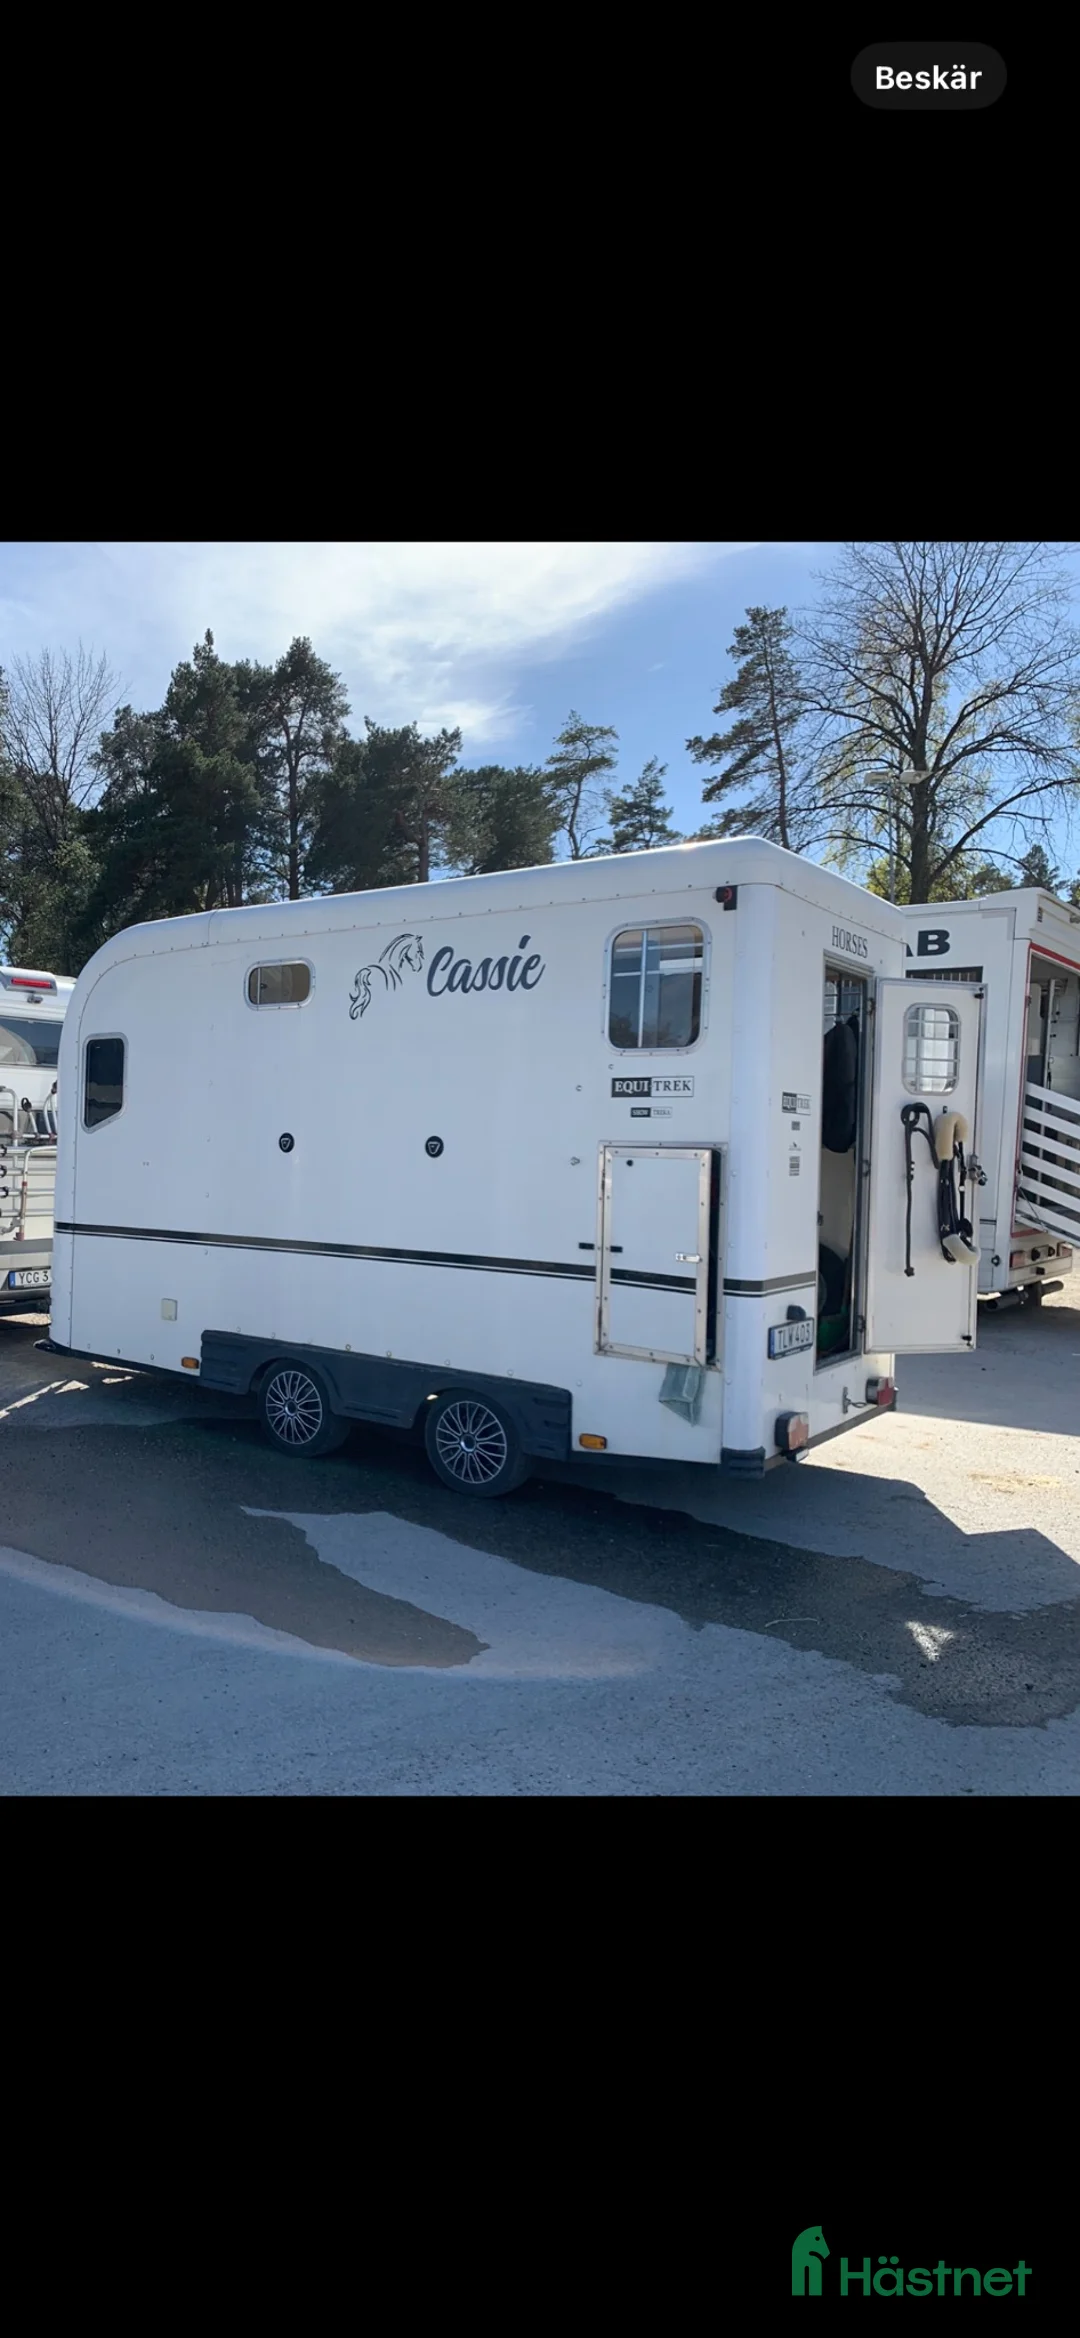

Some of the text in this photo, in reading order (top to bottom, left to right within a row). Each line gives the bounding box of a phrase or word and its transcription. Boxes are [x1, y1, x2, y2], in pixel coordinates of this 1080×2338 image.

[831, 925, 869, 959] HORSES
[906, 929, 951, 957] B
[427, 934, 546, 997] Cassie
[614, 1080, 692, 1094] EQUI TREK
